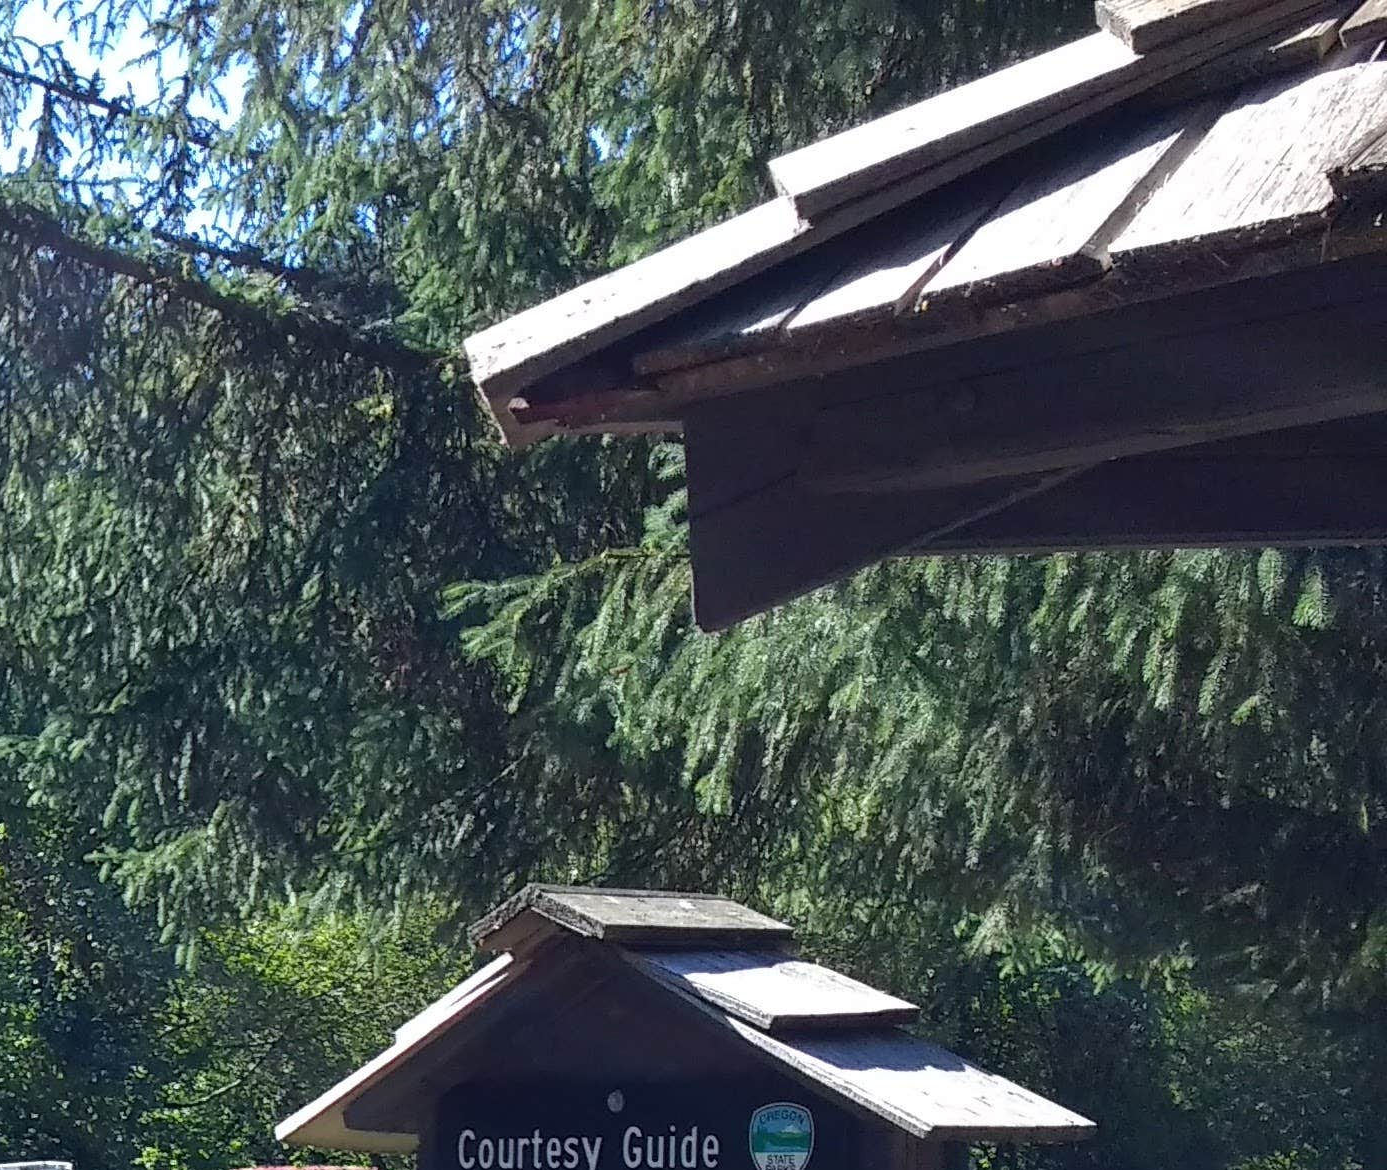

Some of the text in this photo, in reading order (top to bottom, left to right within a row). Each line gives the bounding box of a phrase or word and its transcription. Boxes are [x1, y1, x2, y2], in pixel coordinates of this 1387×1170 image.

[759, 1110, 804, 1125] OREGON
[622, 1125, 720, 1168] Guide
[767, 1155, 795, 1165] STATE
